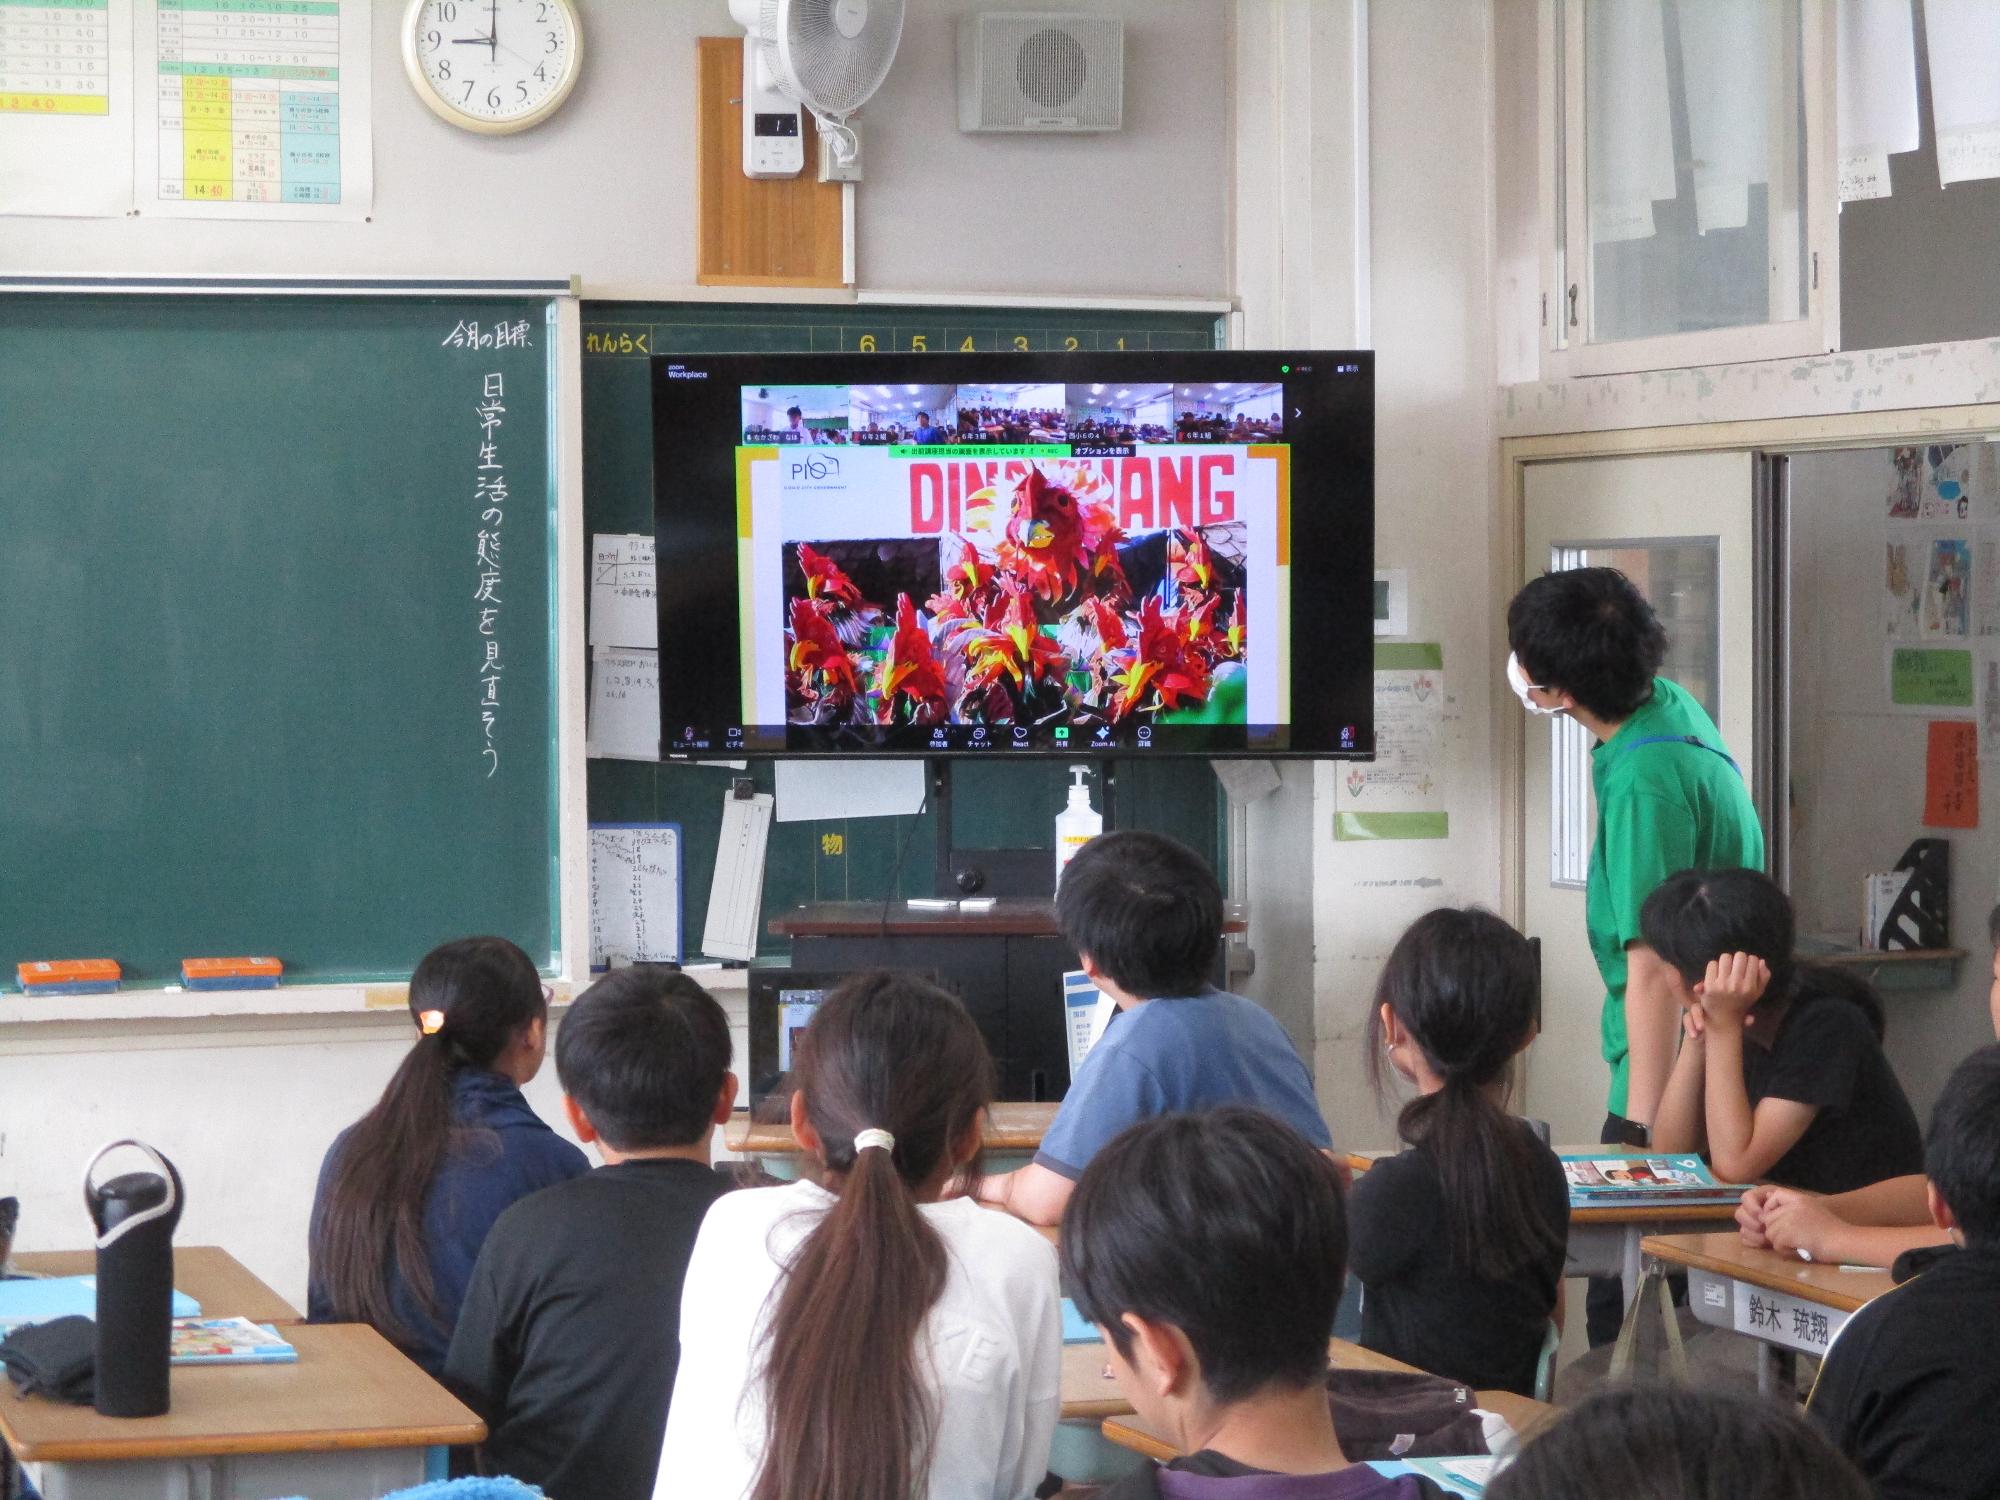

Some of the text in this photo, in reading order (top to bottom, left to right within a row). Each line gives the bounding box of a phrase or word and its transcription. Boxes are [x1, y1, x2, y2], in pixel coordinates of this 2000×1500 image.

[437, 2, 456, 22] 10
[536, 3, 547, 23] 2
[427, 30, 441, 52] 9
[545, 32, 558, 54] 3
[438, 59, 451, 81] 8
[533, 60, 547, 82] 4
[462, 80, 475, 102] 7
[487, 86, 500, 108] 6
[516, 80, 528, 103] 5
[586, 331, 649, 354] れんらく
[859, 334, 1125, 352] 6 5 4 3 2 1
[668, 371, 708, 380] Workplace
[1074, 446, 1131, 455] オプションを表示
[909, 454, 1236, 534] DINANG
[473, 372, 509, 778] 日常生活の態度を見直そう
[967, 740, 993, 748] チャット
[1012, 739, 1030, 747] React
[1055, 740, 1069, 748] 共有
[1090, 740, 1108, 748] Zoom
[821, 832, 844, 856] 物
[1748, 1293, 1782, 1333] 鈴木
